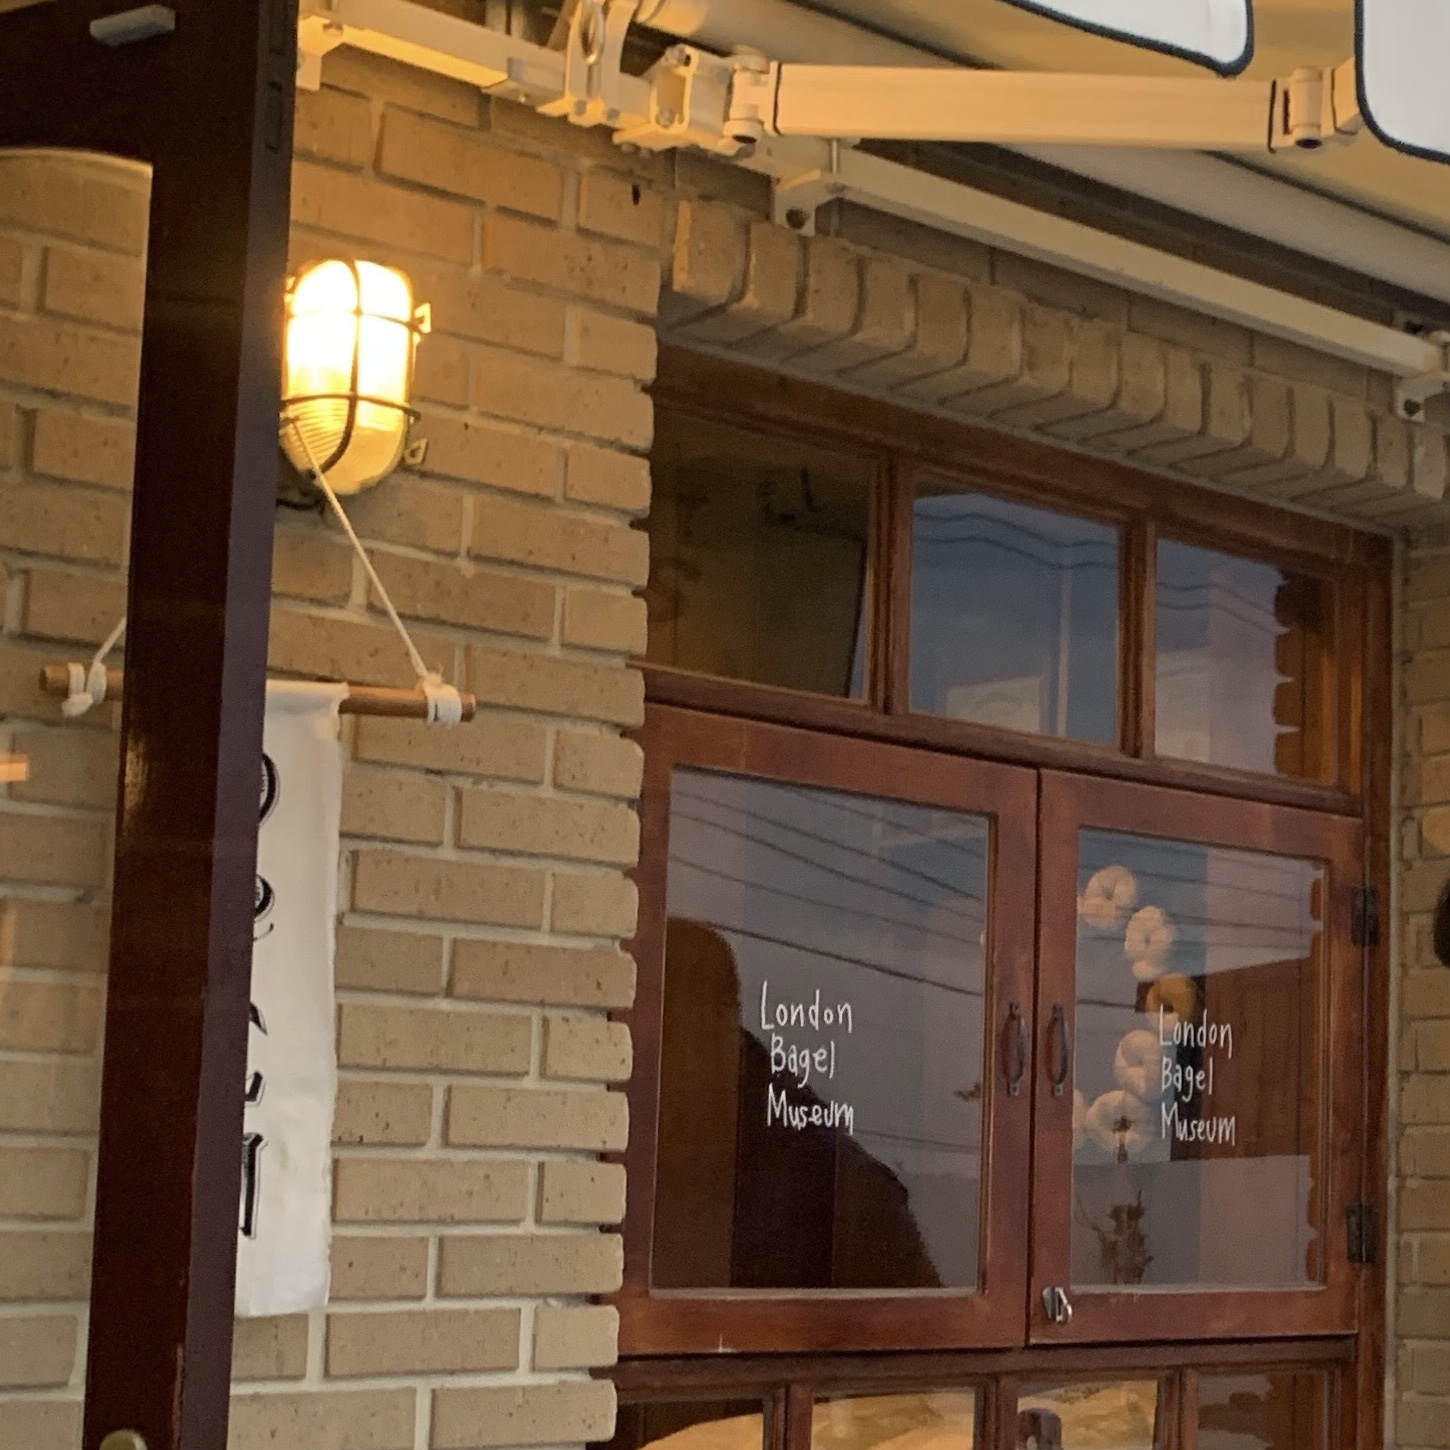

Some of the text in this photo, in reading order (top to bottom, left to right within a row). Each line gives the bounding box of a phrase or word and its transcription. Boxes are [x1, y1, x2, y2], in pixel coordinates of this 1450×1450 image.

[760, 979, 853, 1034] London
[1159, 1002, 1233, 1060] London
[770, 1031, 836, 1089] Bagel
[1161, 1055, 1214, 1103] Bagel
[766, 1081, 854, 1137] Museum
[1161, 1101, 1236, 1147] Museum
